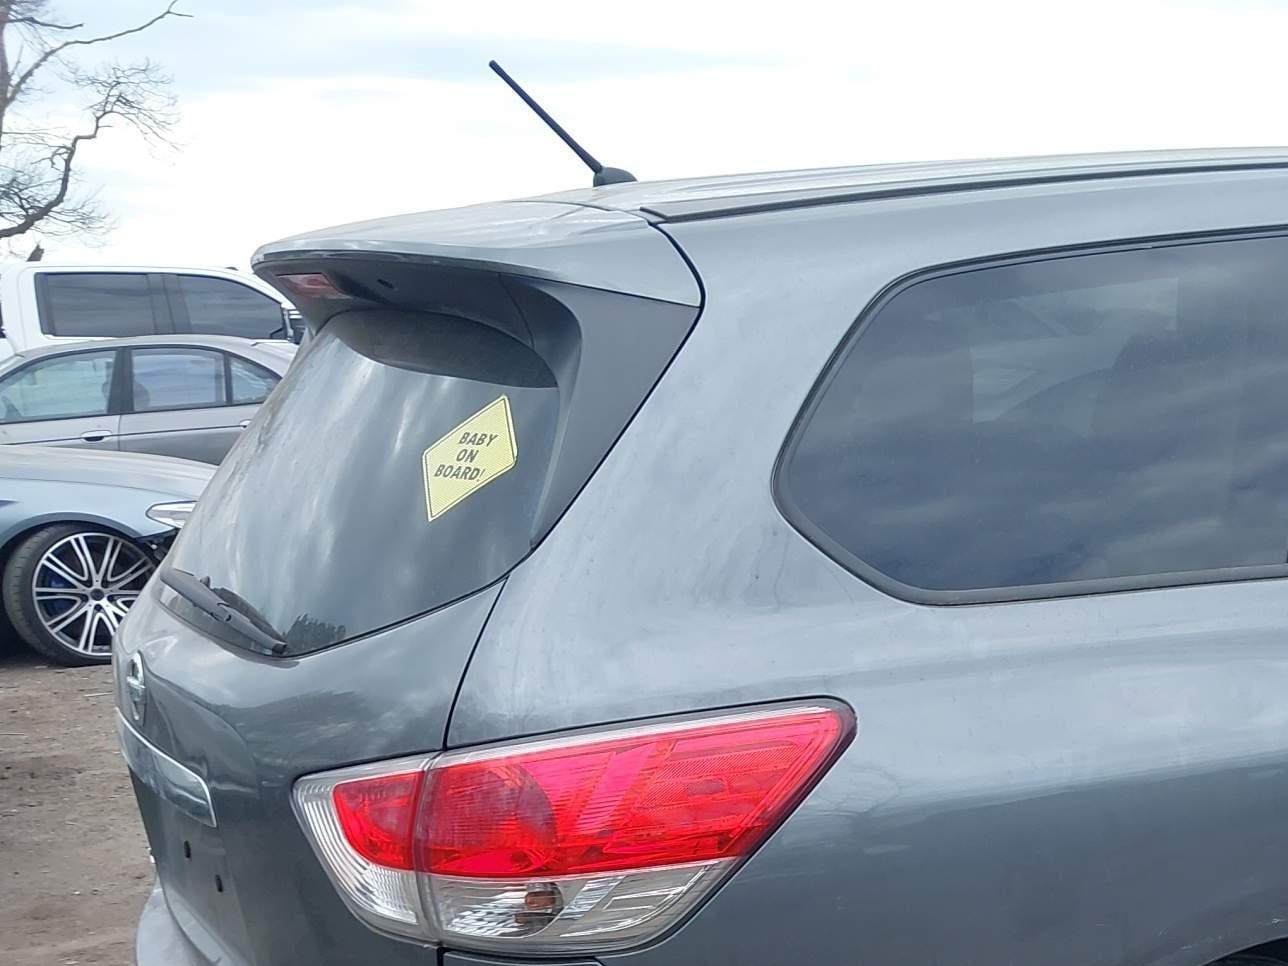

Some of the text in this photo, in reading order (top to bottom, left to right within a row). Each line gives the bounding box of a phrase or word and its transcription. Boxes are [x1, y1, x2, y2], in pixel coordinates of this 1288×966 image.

[459, 432, 499, 447] BABY
[456, 449, 479, 463] ON
[434, 464, 486, 482] BOARD!
